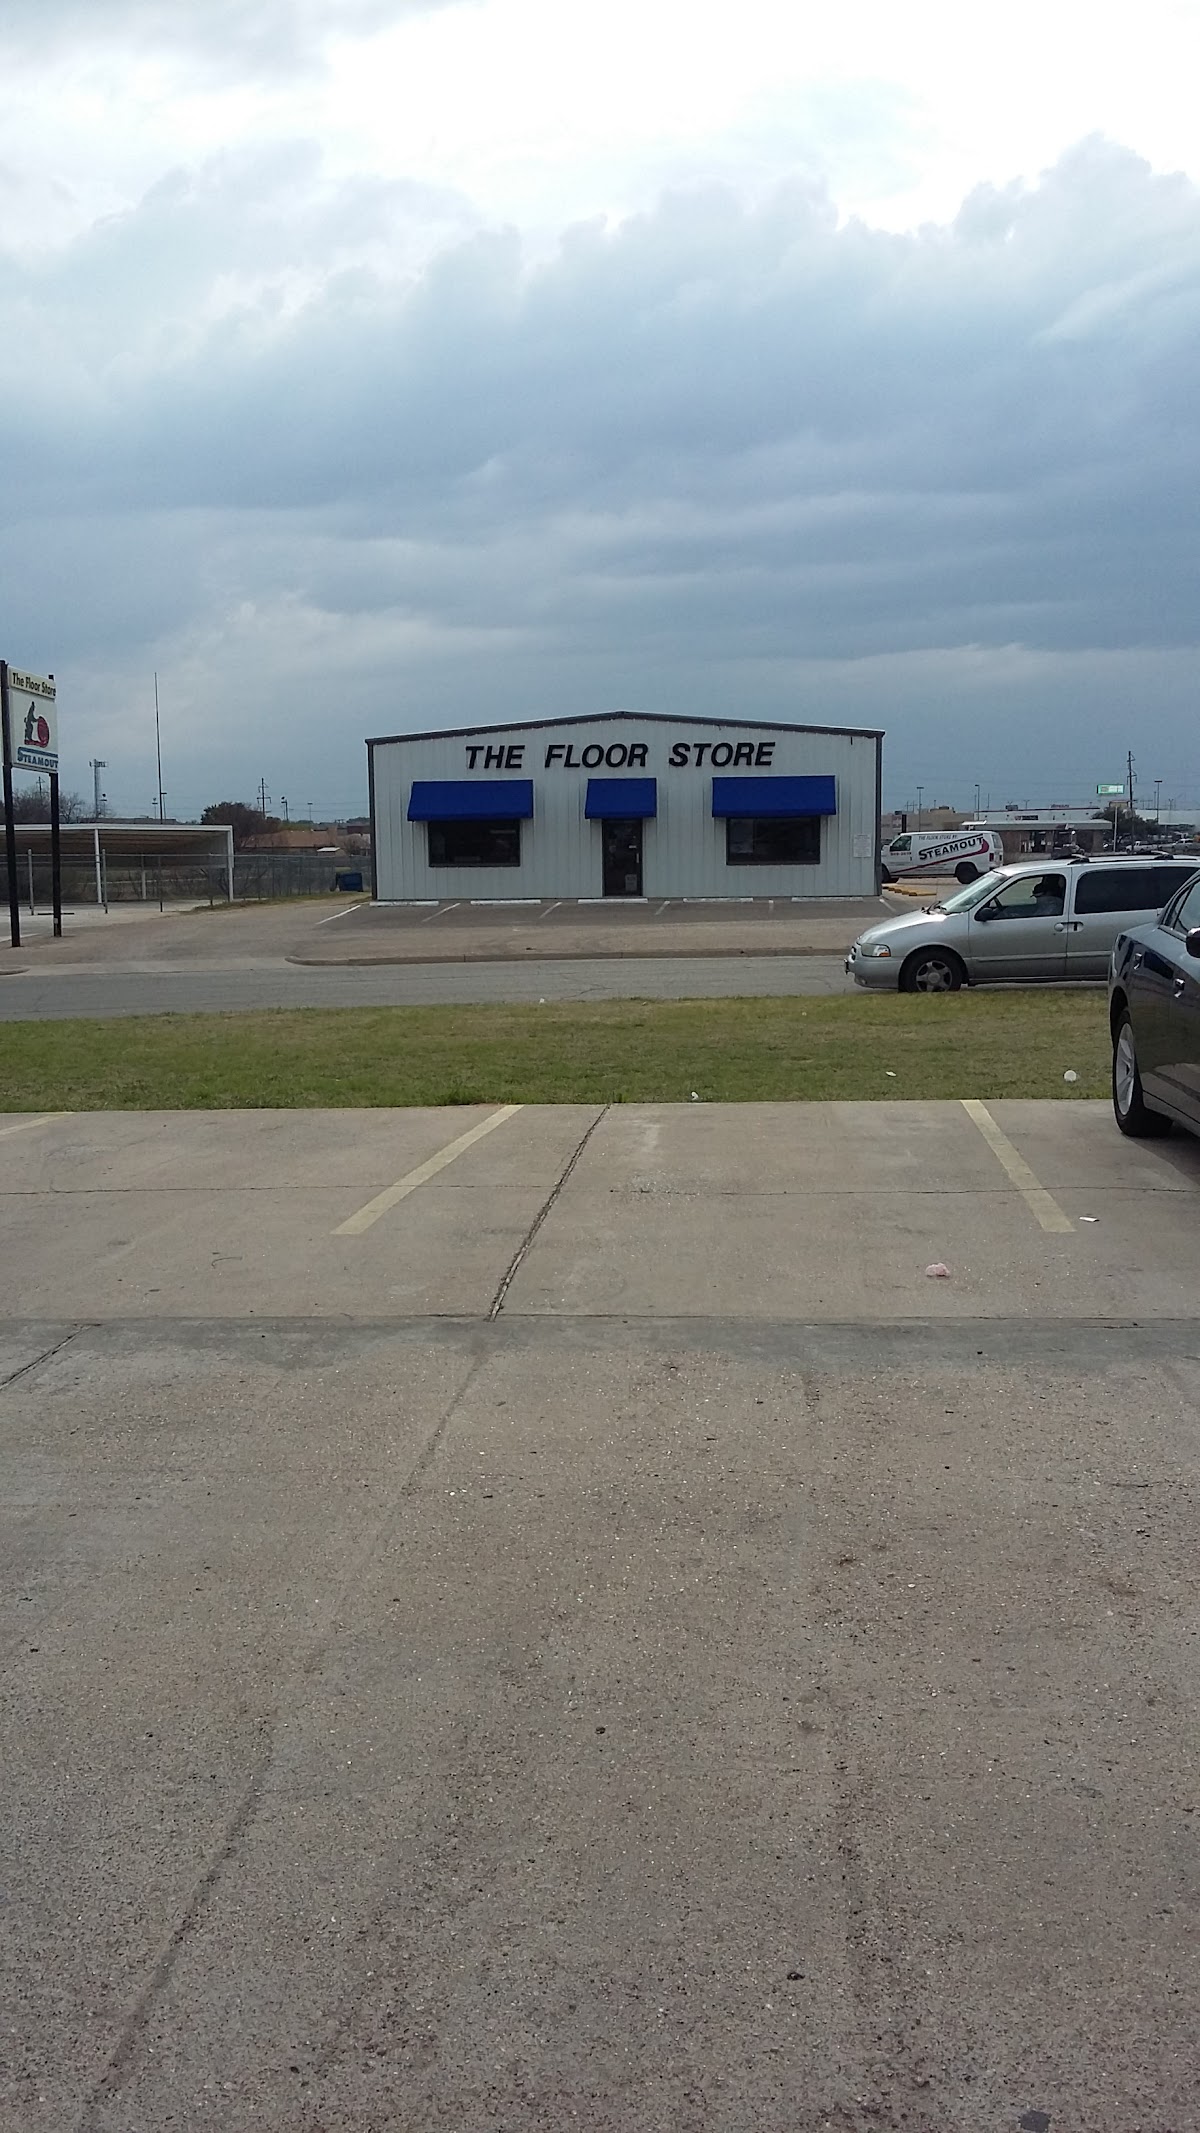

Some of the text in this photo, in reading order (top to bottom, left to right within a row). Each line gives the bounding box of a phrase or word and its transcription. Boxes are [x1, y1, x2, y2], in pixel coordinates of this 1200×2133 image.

[12, 672, 56, 697] The Floor Store
[17, 748, 58, 768] STEAMOUT
[465, 741, 776, 769] THE FLOOR STORE
[919, 836, 984, 861] STEAMOUT
